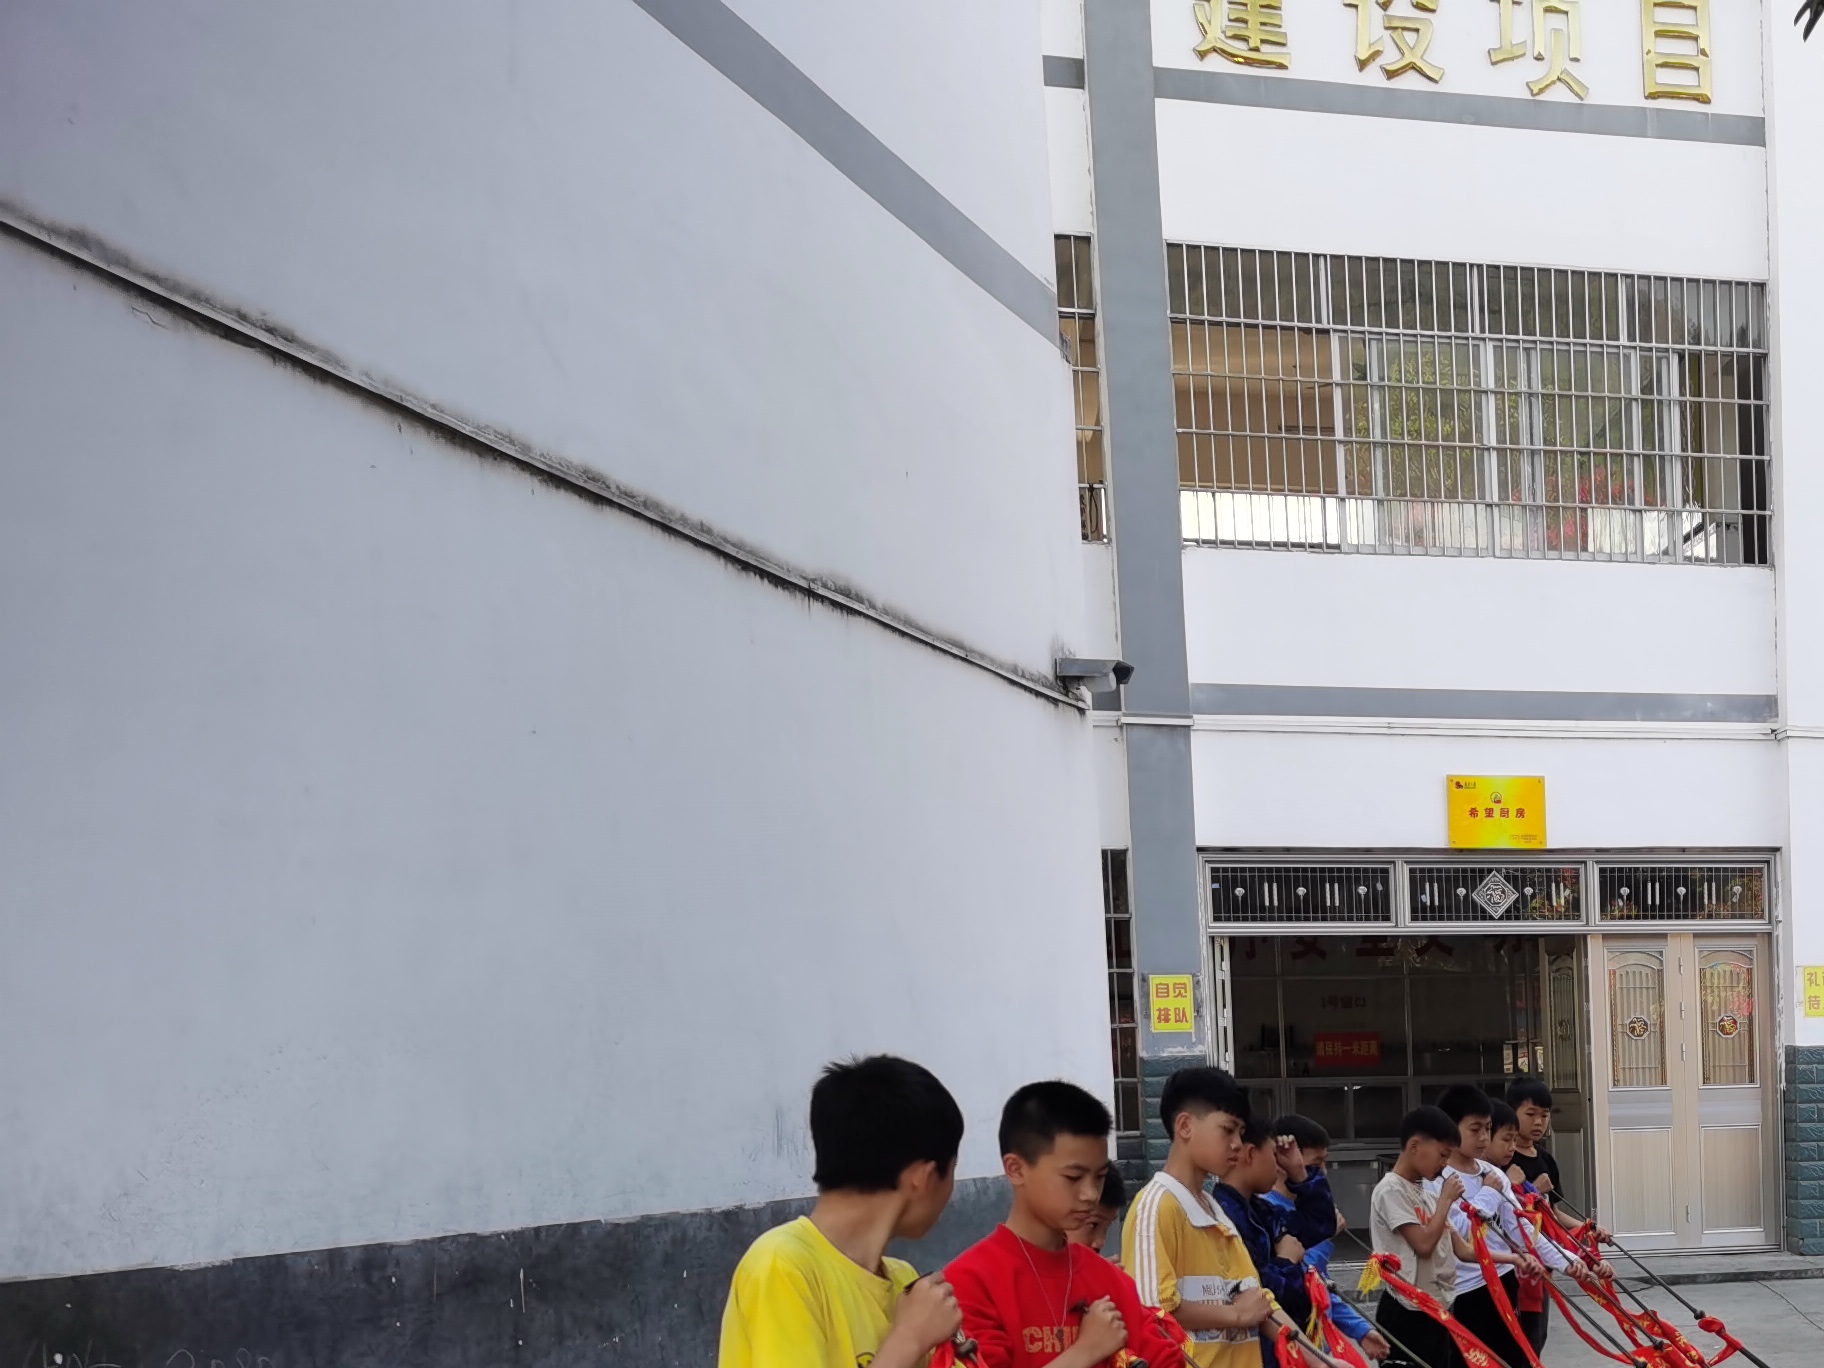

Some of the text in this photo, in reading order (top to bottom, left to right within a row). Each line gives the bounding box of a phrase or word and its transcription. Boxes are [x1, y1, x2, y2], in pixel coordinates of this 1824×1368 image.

[1192, 0, 1712, 104] 建设项目
[1468, 806, 1526, 819] 希望厨房
[1155, 982, 1188, 999] 自觉
[1156, 1007, 1189, 1024] 排队
[1316, 1041, 1378, 1056] 请保持一米距离
